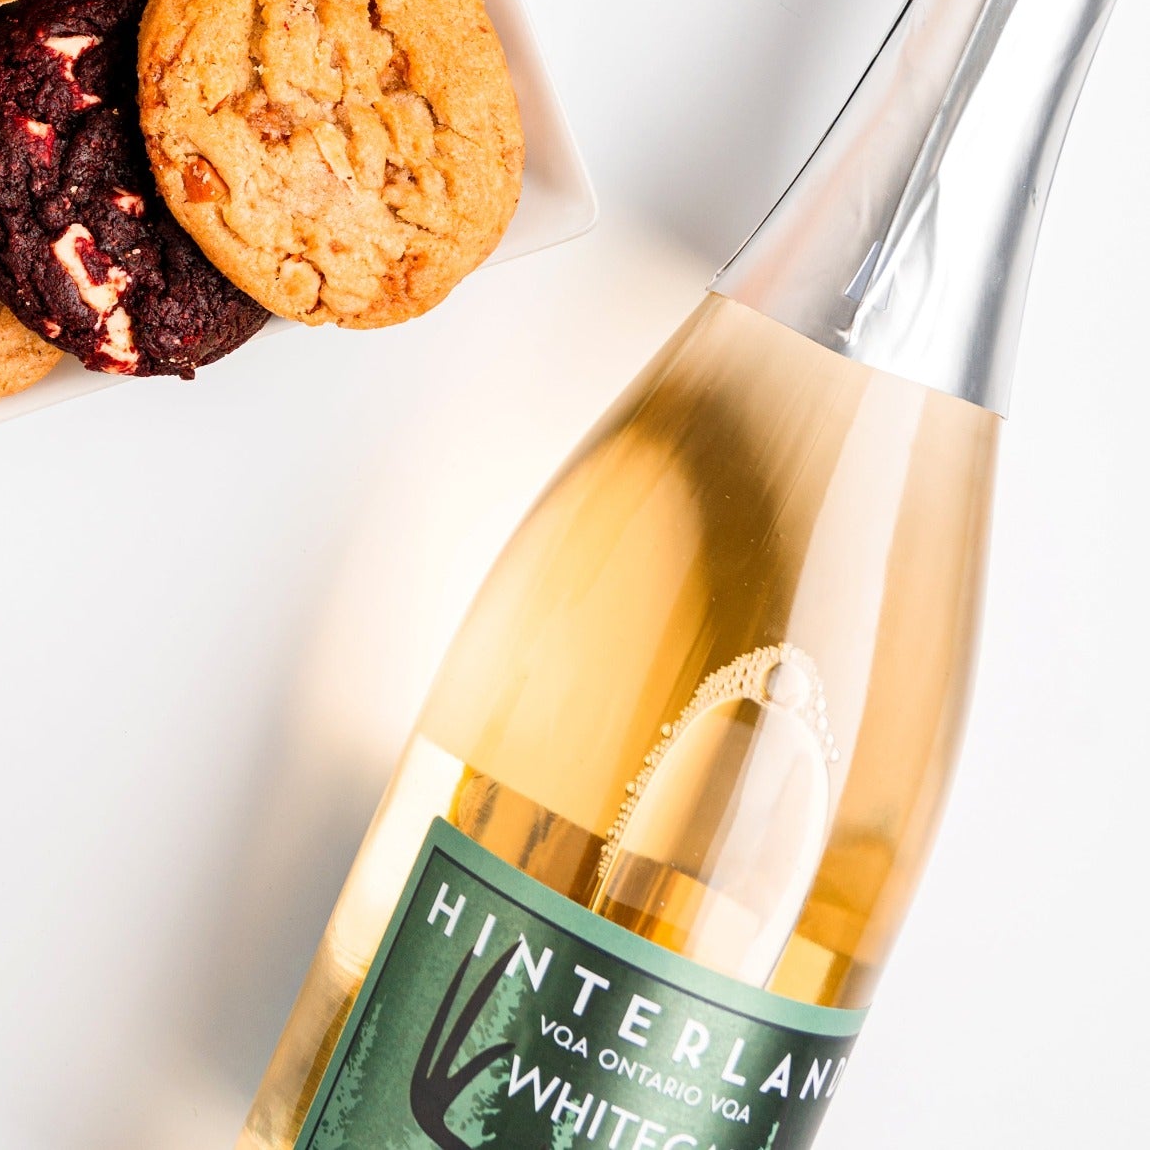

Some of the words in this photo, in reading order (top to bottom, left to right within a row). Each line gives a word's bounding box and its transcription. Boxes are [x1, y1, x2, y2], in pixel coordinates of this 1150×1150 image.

[541, 1014, 588, 1059] VQA
[598, 1049, 702, 1107] ONTARIO
[711, 1093, 750, 1125] VQA
